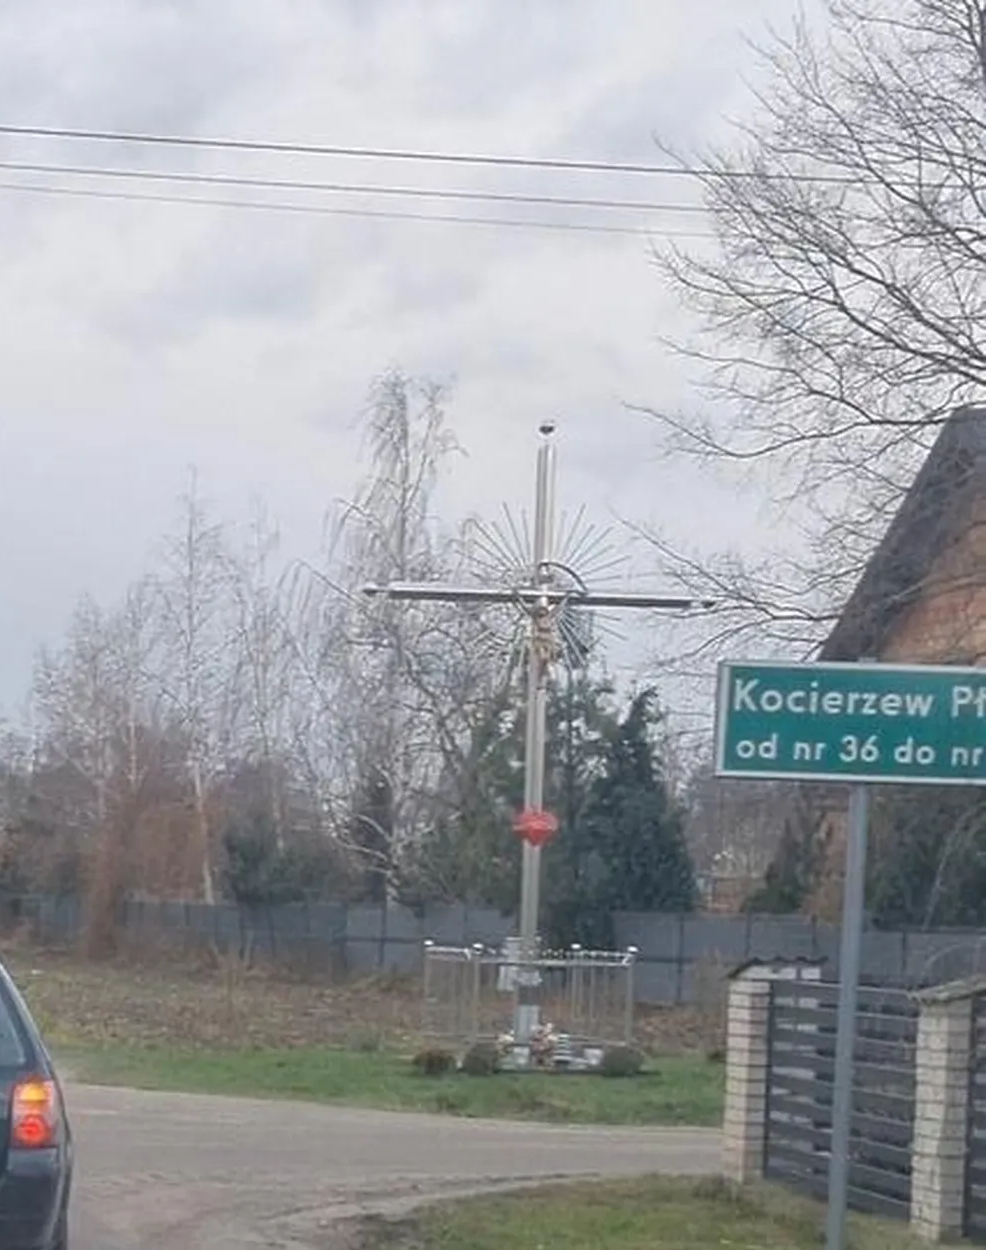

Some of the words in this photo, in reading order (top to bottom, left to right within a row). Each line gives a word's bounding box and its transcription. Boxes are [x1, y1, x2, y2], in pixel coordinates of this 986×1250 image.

[733, 678, 933, 717] Kocierzew
[736, 733, 778, 760] od
[793, 741, 827, 760] nr
[839, 735, 879, 763] 36
[894, 736, 935, 765] do
[951, 746, 984, 767] nr
